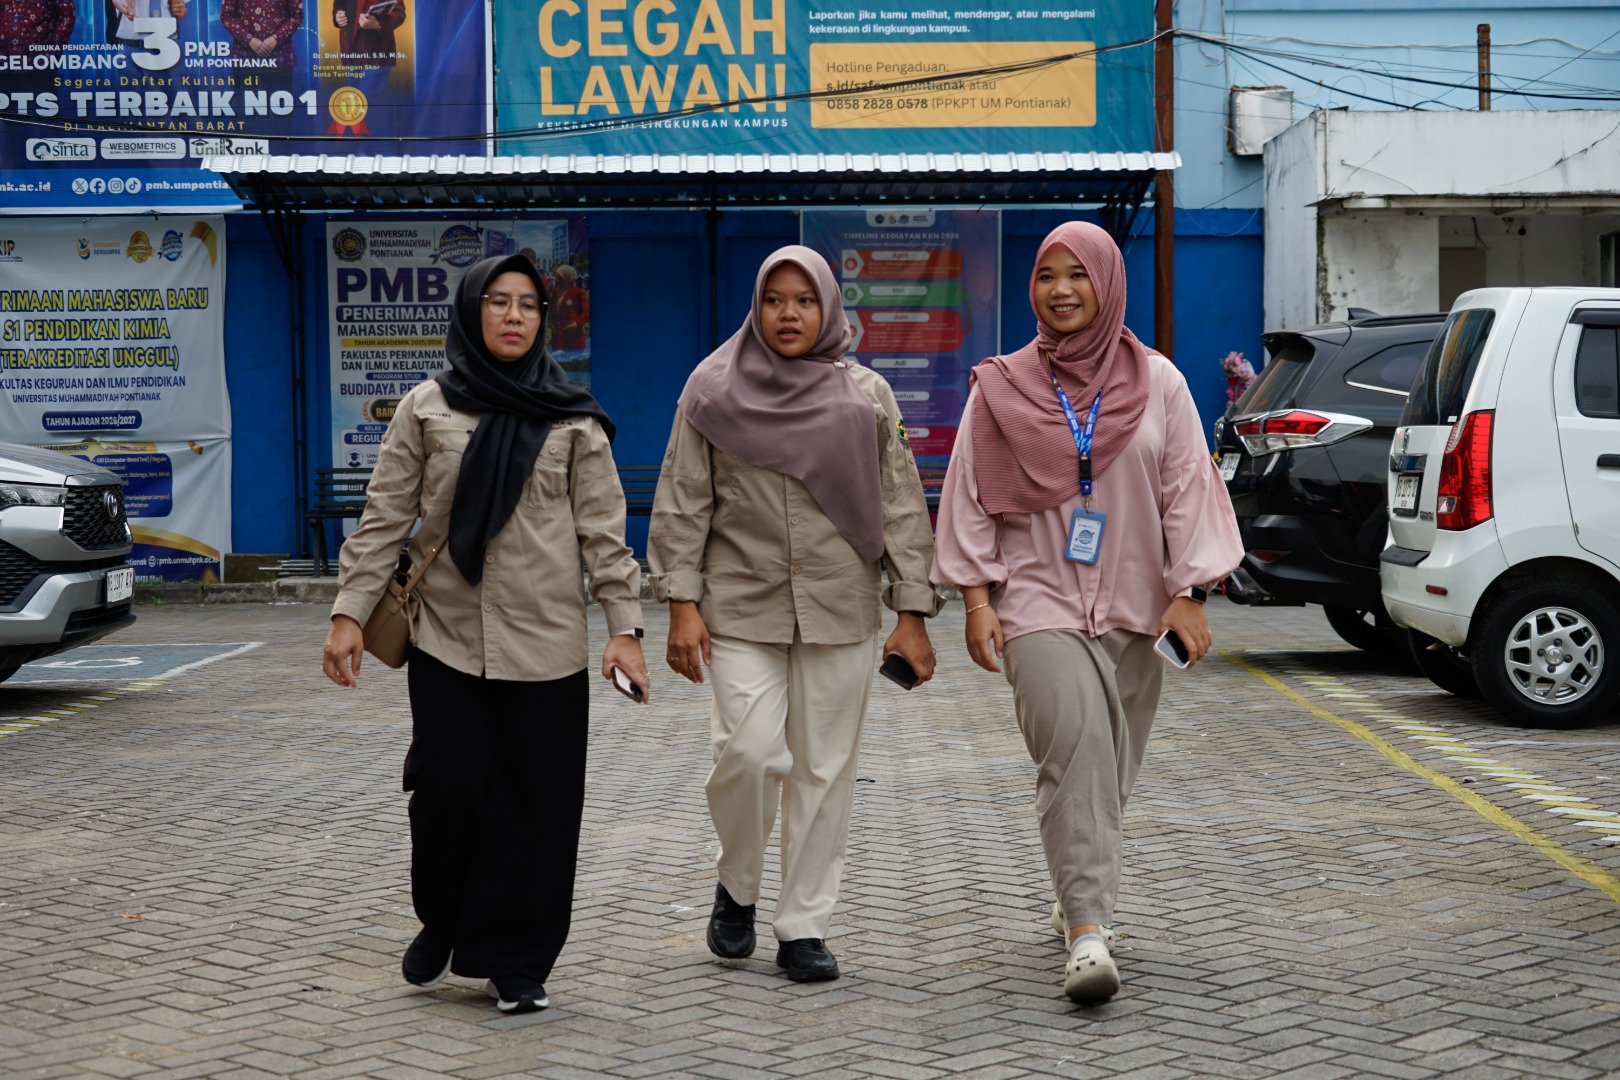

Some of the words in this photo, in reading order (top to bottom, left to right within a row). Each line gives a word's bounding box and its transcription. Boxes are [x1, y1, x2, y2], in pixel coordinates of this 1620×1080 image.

[809, 11, 855, 21] Laporkan
[859, 11, 877, 21] jika
[880, 11, 908, 19] kamu
[911, 10, 951, 20] melihat,
[954, 10, 1013, 20] mendengar,
[1016, 10, 1038, 19] atau
[1042, 9, 1096, 20] mengalami
[539, 0, 787, 58] CEGAH
[809, 24, 860, 34] kekerasan
[861, 24, 871, 33] di
[872, 24, 927, 35] lingkungan
[929, 23, 970, 34] kampus.
[29, 44, 61, 52] DIBUKA
[62, 43, 124, 52] PENDAFTARAN
[131, 17, 181, 71] 3
[185, 41, 231, 57] PMB
[0, 54, 127, 70] GELOMBANG
[185, 58, 204, 68] UM
[206, 58, 278, 68] PONTIANAK
[827, 61, 872, 73] Hotline
[876, 61, 950, 75] Pengaduan:
[333, 71, 366, 79] Tertinggi
[54, 77, 111, 88] Segera
[120, 76, 173, 86] Daftar
[182, 76, 236, 86] Kuliah
[244, 76, 259, 86] di
[968, 80, 996, 90] atau
[541, 63, 787, 115] LAWAN!
[0, 91, 59, 117] PTS
[70, 90, 236, 117] TERBAIK
[827, 99, 860, 110] 0858
[863, 99, 894, 110] 2828
[897, 98, 928, 109] 0578
[932, 97, 977, 110] (PPKPT
[981, 98, 1001, 109] UM
[1005, 96, 1072, 109] Pontianak)
[195, 121, 246, 131] BARAT
[734, 118, 788, 128] KAMPUS
[52, 141, 89, 158] sinta
[109, 142, 177, 150] WEBOMETRICS
[146, 180, 231, 191] pmb.umpontia
[370, 229, 418, 239] UNIVERSITAS
[844, 232, 879, 240] TIMELINE
[880, 232, 921, 240] KEGIATAN
[922, 232, 940, 240] KKN
[370, 239, 432, 248] MUHAMMADIYAH
[370, 249, 414, 258] PONTIANAK
[892, 253, 909, 261] April
[337, 267, 450, 303] PMB
[68, 289, 165, 312] MAHASISWA
[166, 287, 209, 311] BARU
[342, 306, 449, 321] PENERIMAAN
[3, 319, 20, 341] S1
[24, 318, 121, 341] PENDIDIKAN
[123, 317, 171, 340] KIMIA
[337, 324, 419, 337] MAHASISWA
[421, 323, 450, 336] BAR
[112, 345, 180, 371] UNGGUL)
[341, 350, 388, 360] FAKULTAS
[389, 350, 445, 360] PERIKANAN
[341, 361, 363, 371] DAN
[365, 361, 390, 371] ILMU
[392, 360, 444, 370] KELAUTAN
[34, 378, 84, 390] KEGURUAN
[85, 377, 105, 389] DAN
[107, 377, 129, 389] ILMU
[131, 375, 186, 388] PENDIDIKAN
[340, 383, 396, 396] BUDIDAYA
[13, 394, 57, 403] UNIVERSITAS
[58, 392, 119, 403] MUHAMMADIYAH
[120, 391, 162, 402] PONTIANAK
[45, 416, 71, 427] TAHUN
[71, 415, 100, 427] AJARAN
[100, 413, 137, 427] 2026/2027
